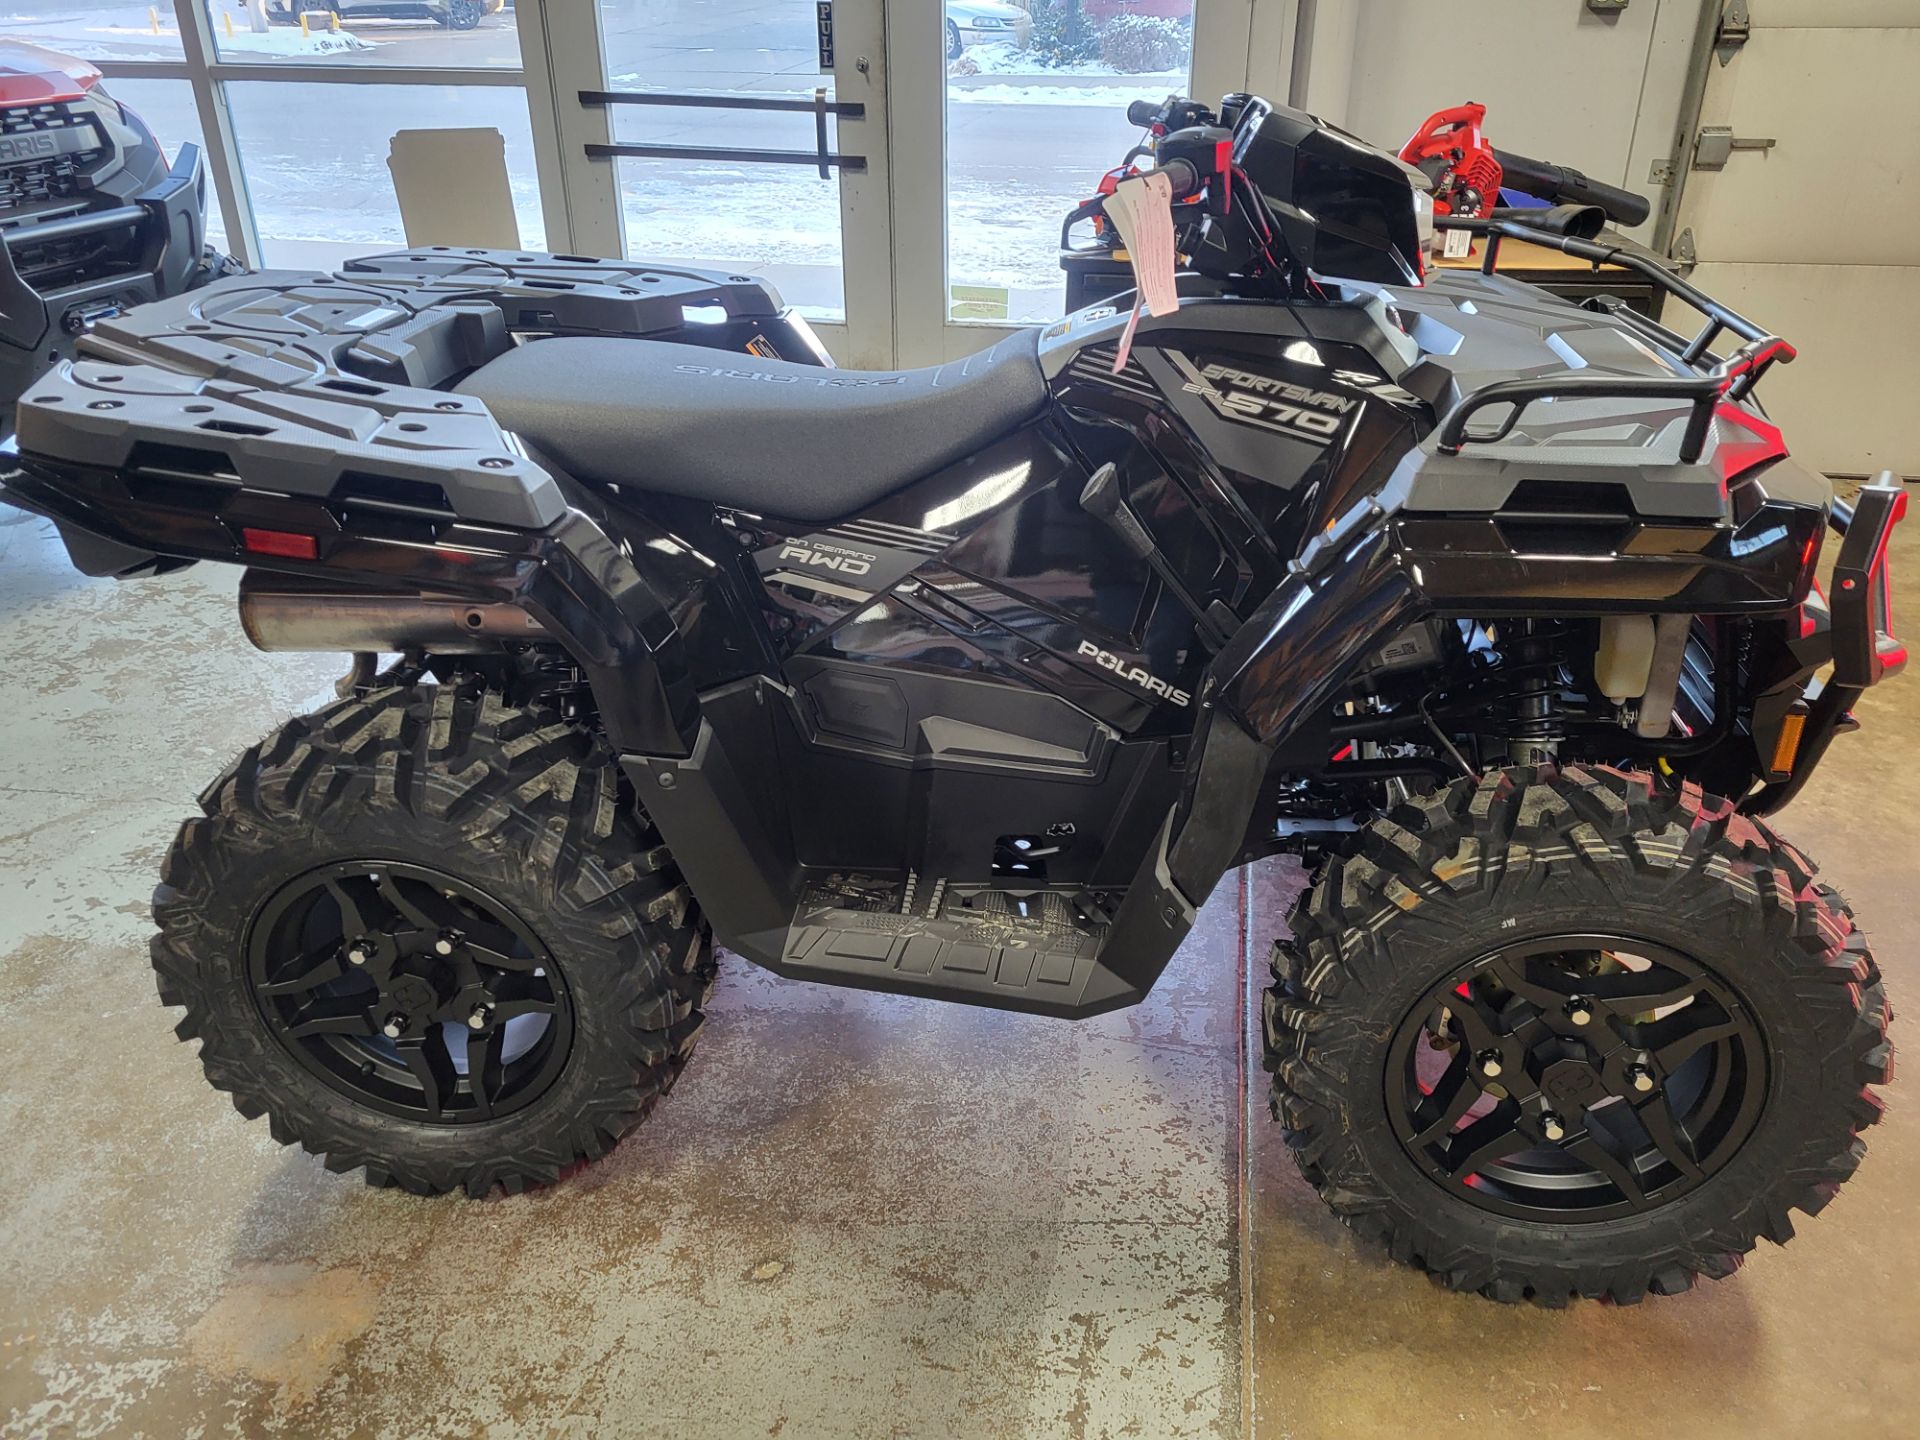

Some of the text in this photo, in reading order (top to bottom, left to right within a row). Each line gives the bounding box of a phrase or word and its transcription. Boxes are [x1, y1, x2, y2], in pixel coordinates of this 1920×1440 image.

[820, 4, 832, 66] PULL
[673, 363, 907, 387] POLARIS
[1199, 363, 1357, 414] SPORTSMAN
[1182, 382, 1342, 434] EFI 570
[779, 545, 871, 575] AWD
[1077, 639, 1191, 707] POLARIS
